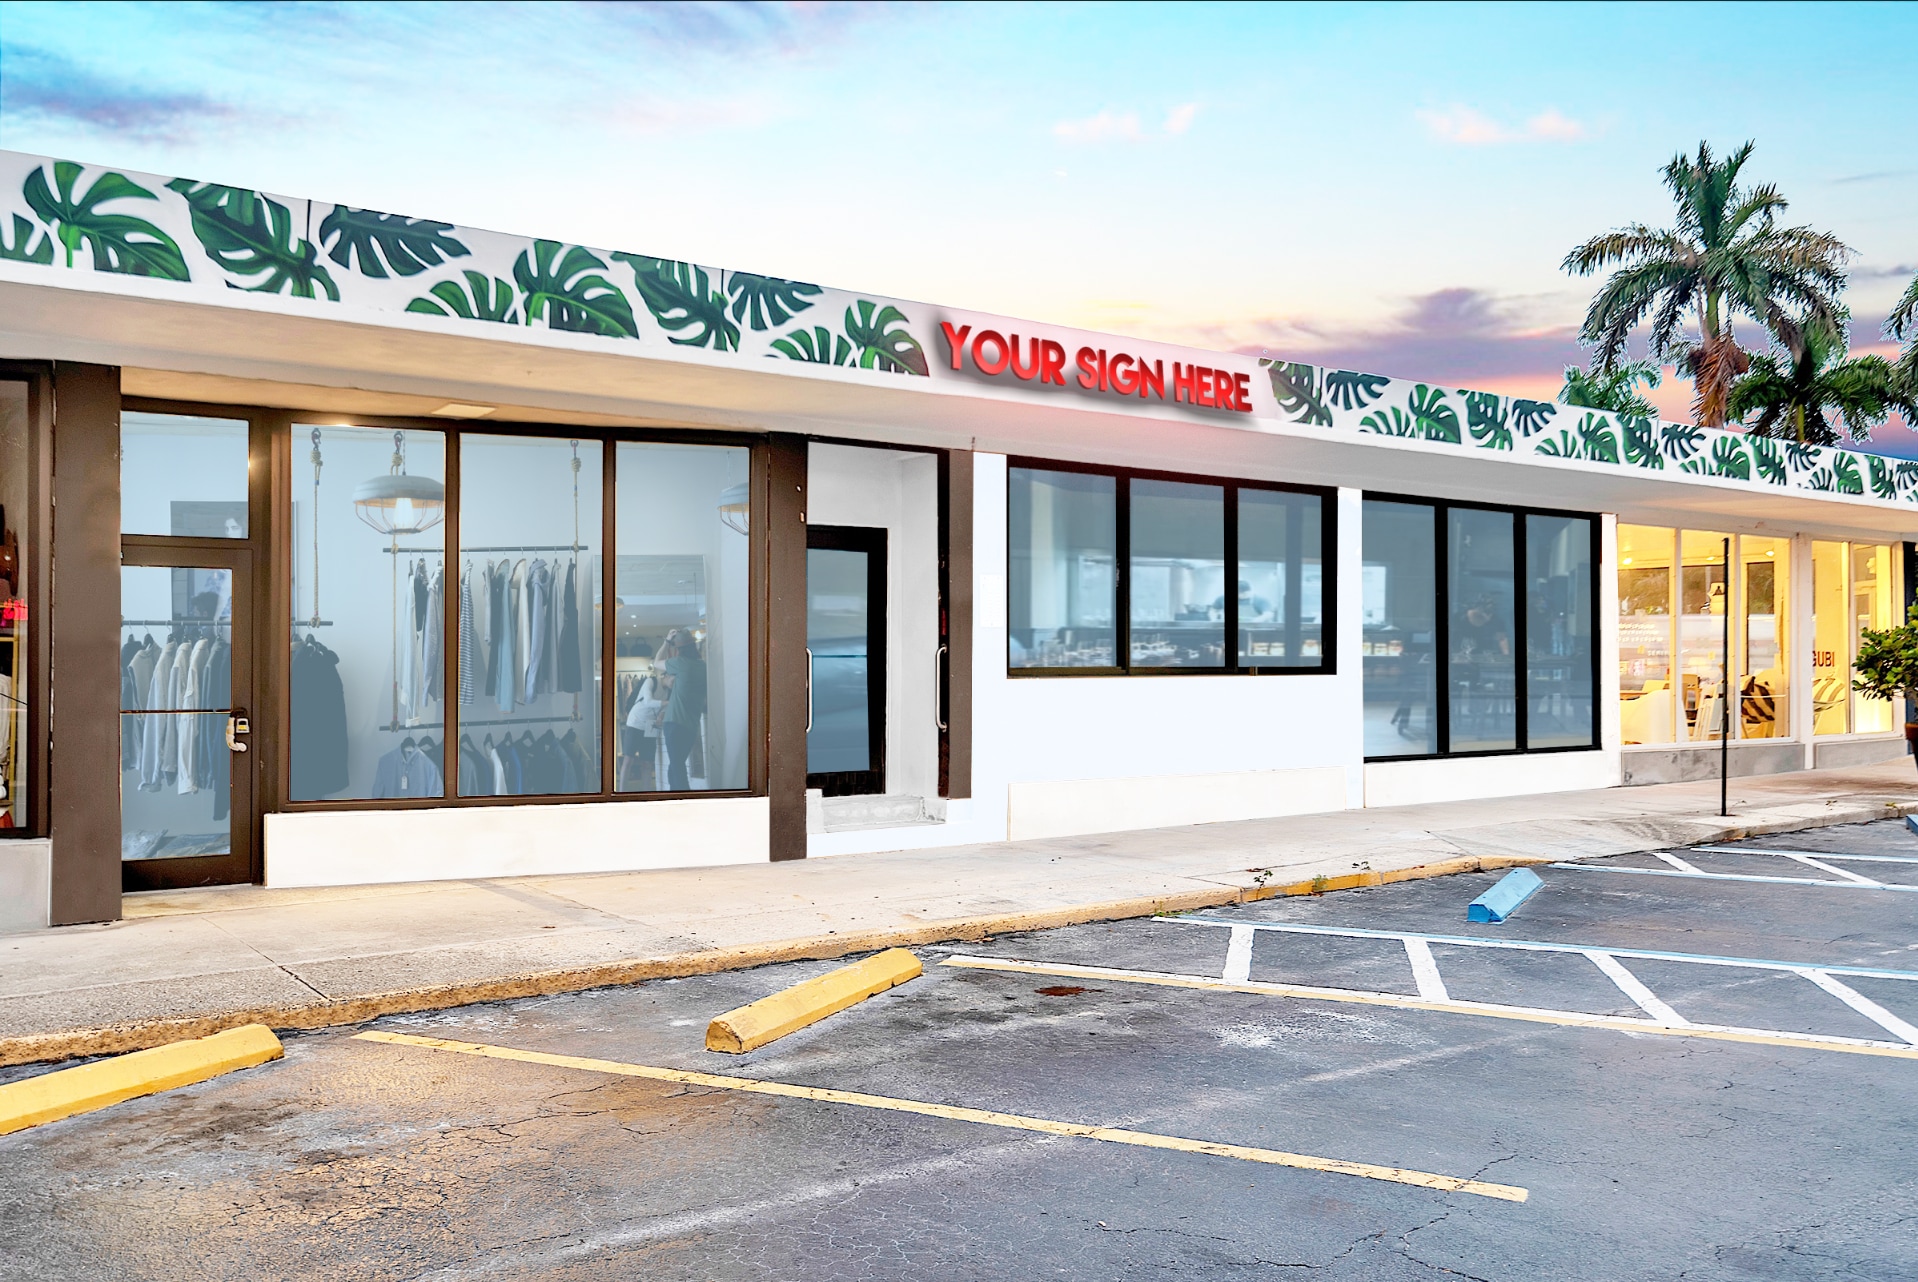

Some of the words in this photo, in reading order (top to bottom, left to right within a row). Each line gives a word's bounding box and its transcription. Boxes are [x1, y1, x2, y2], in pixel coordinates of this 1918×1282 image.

[940, 321, 1067, 386] YOUR
[1076, 346, 1166, 400] SIGN
[1172, 361, 1254, 413] HERE
